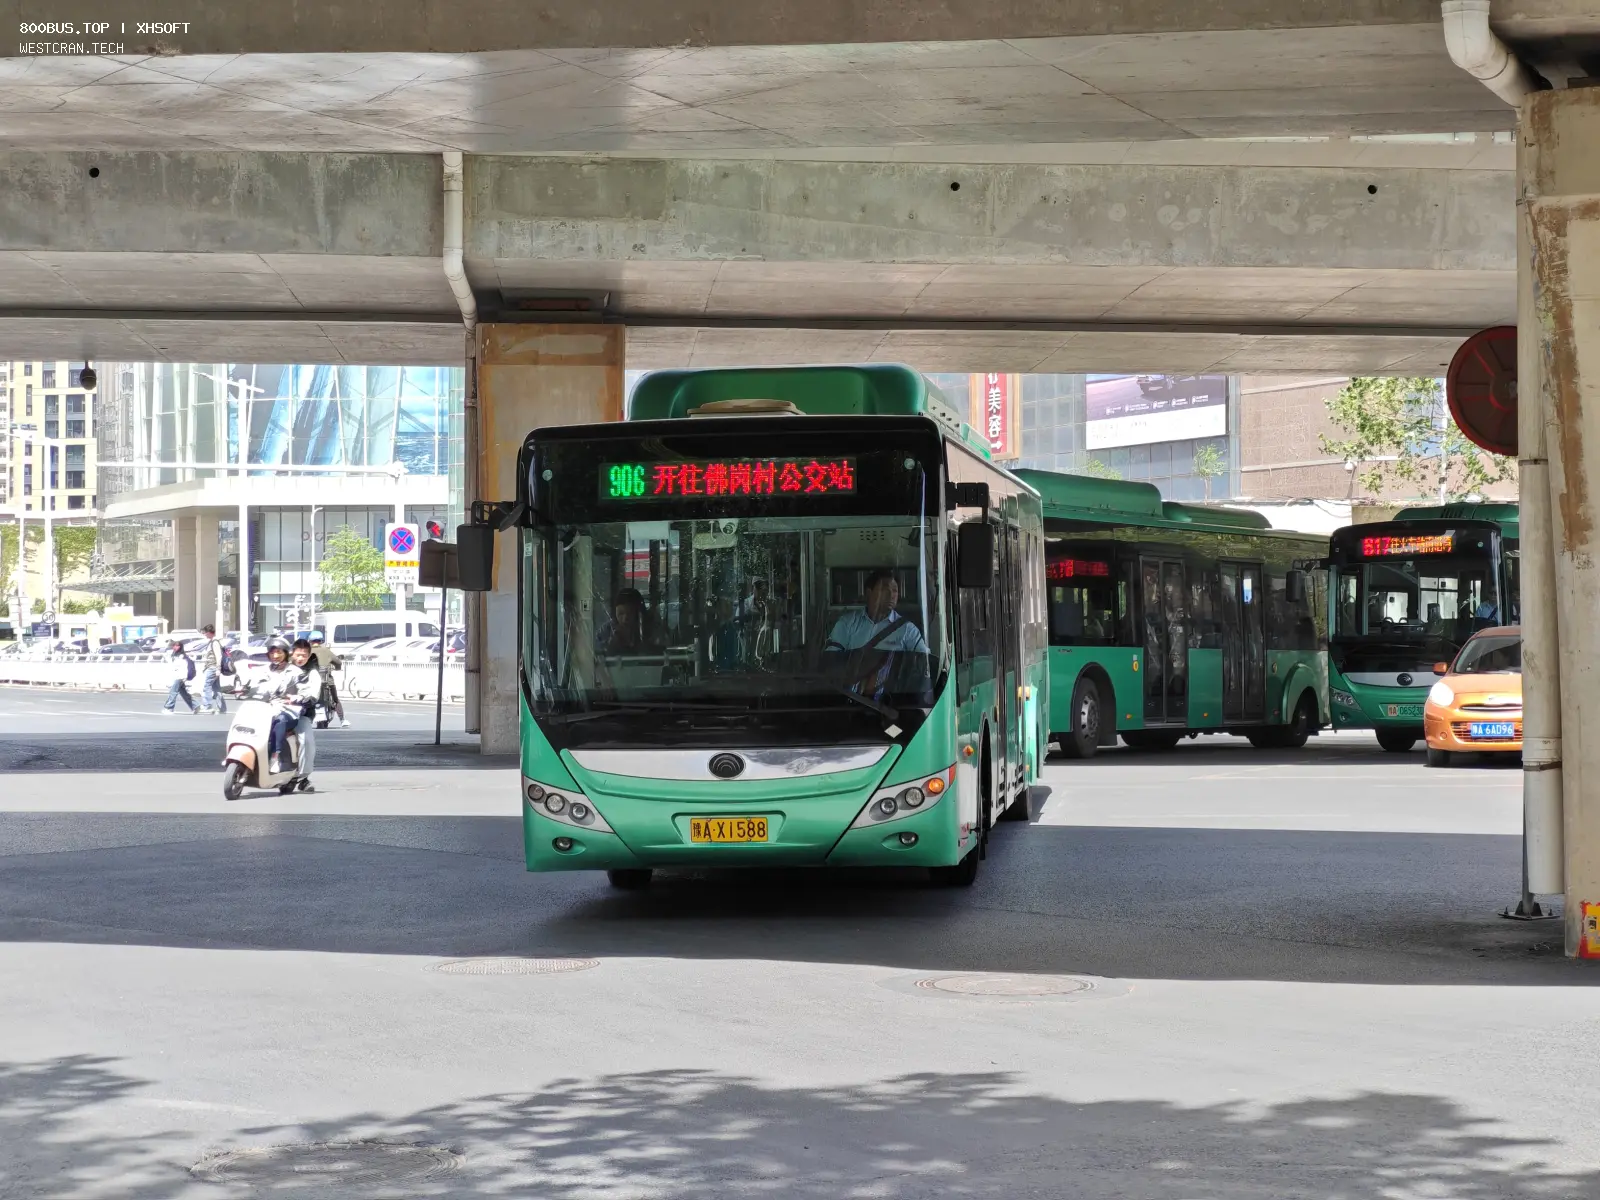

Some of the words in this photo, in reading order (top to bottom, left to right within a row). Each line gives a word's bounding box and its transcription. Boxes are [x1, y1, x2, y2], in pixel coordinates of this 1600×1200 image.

[609, 464, 645, 497] 906
[652, 460, 854, 495] 开往佛岗村公交站
